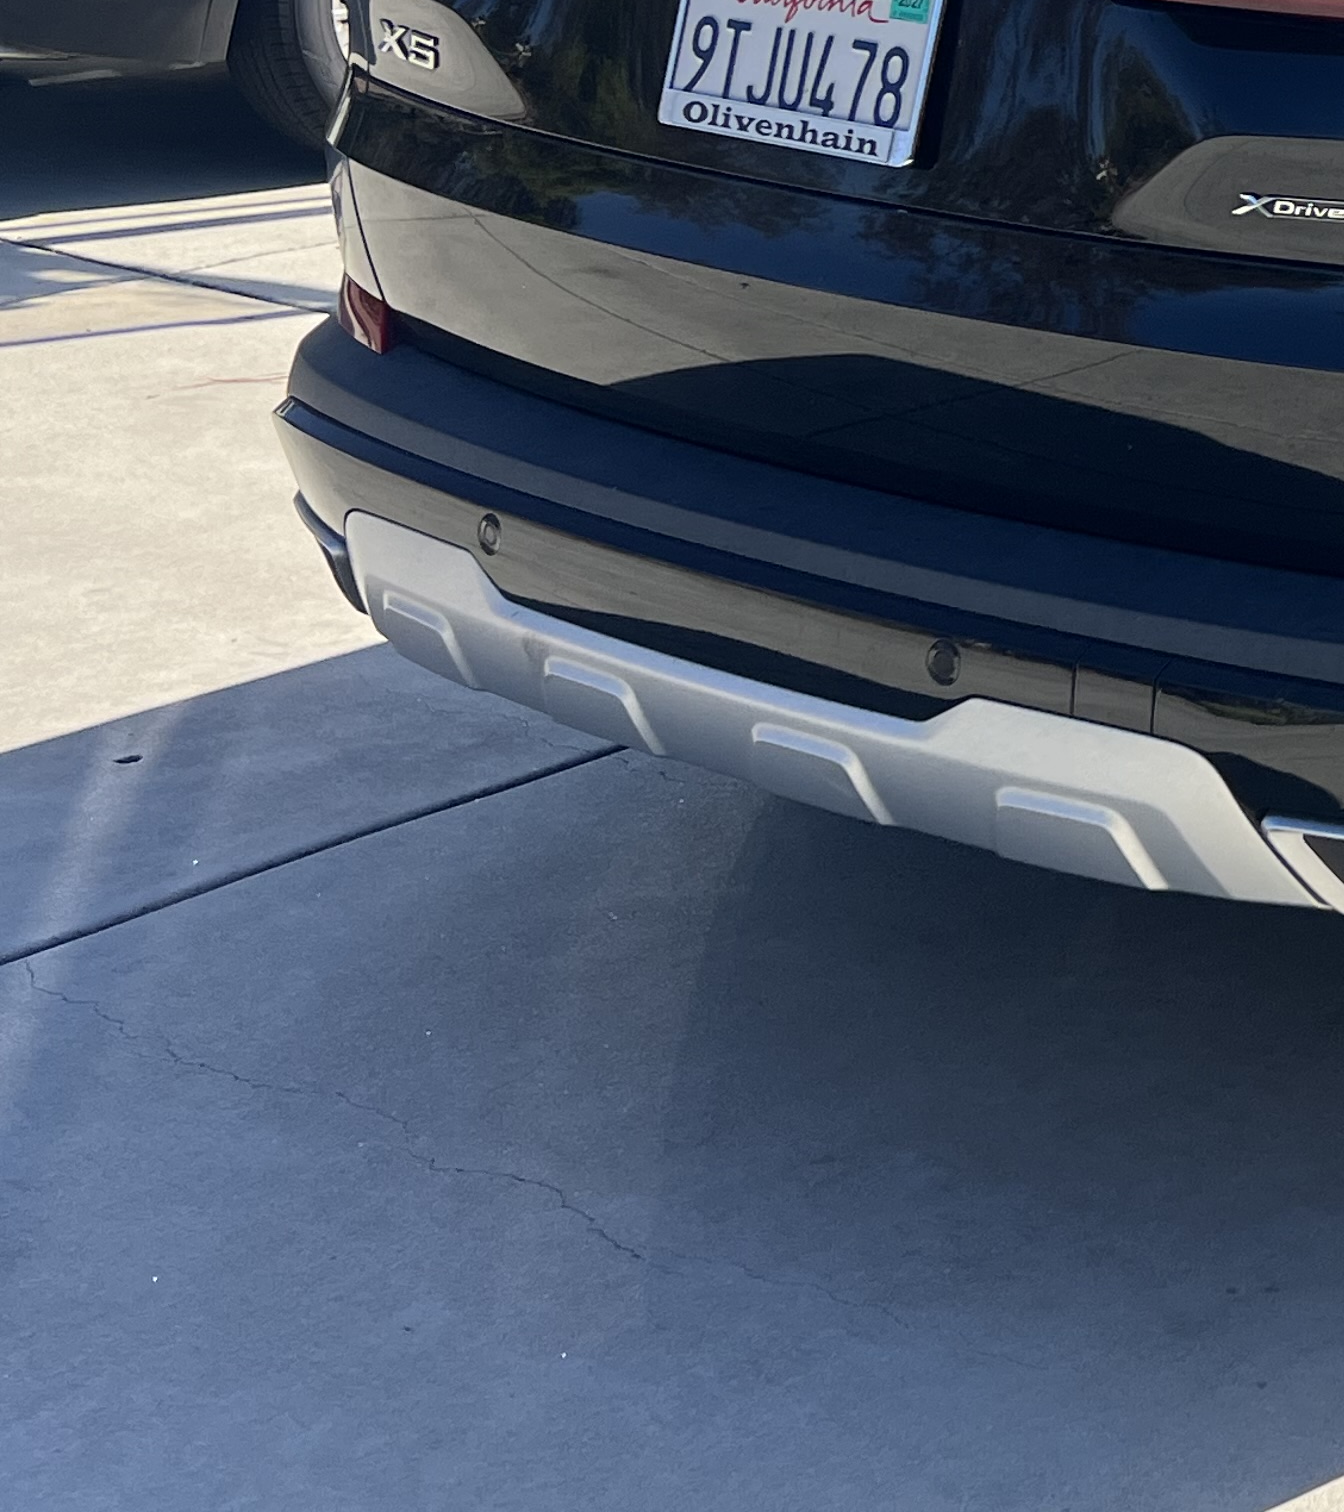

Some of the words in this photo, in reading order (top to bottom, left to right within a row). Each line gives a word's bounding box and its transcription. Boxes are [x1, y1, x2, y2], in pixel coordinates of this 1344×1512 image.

[378, 18, 440, 71] X5
[682, 15, 910, 129] 9TJU478
[682, 100, 878, 156] Olivenhain
